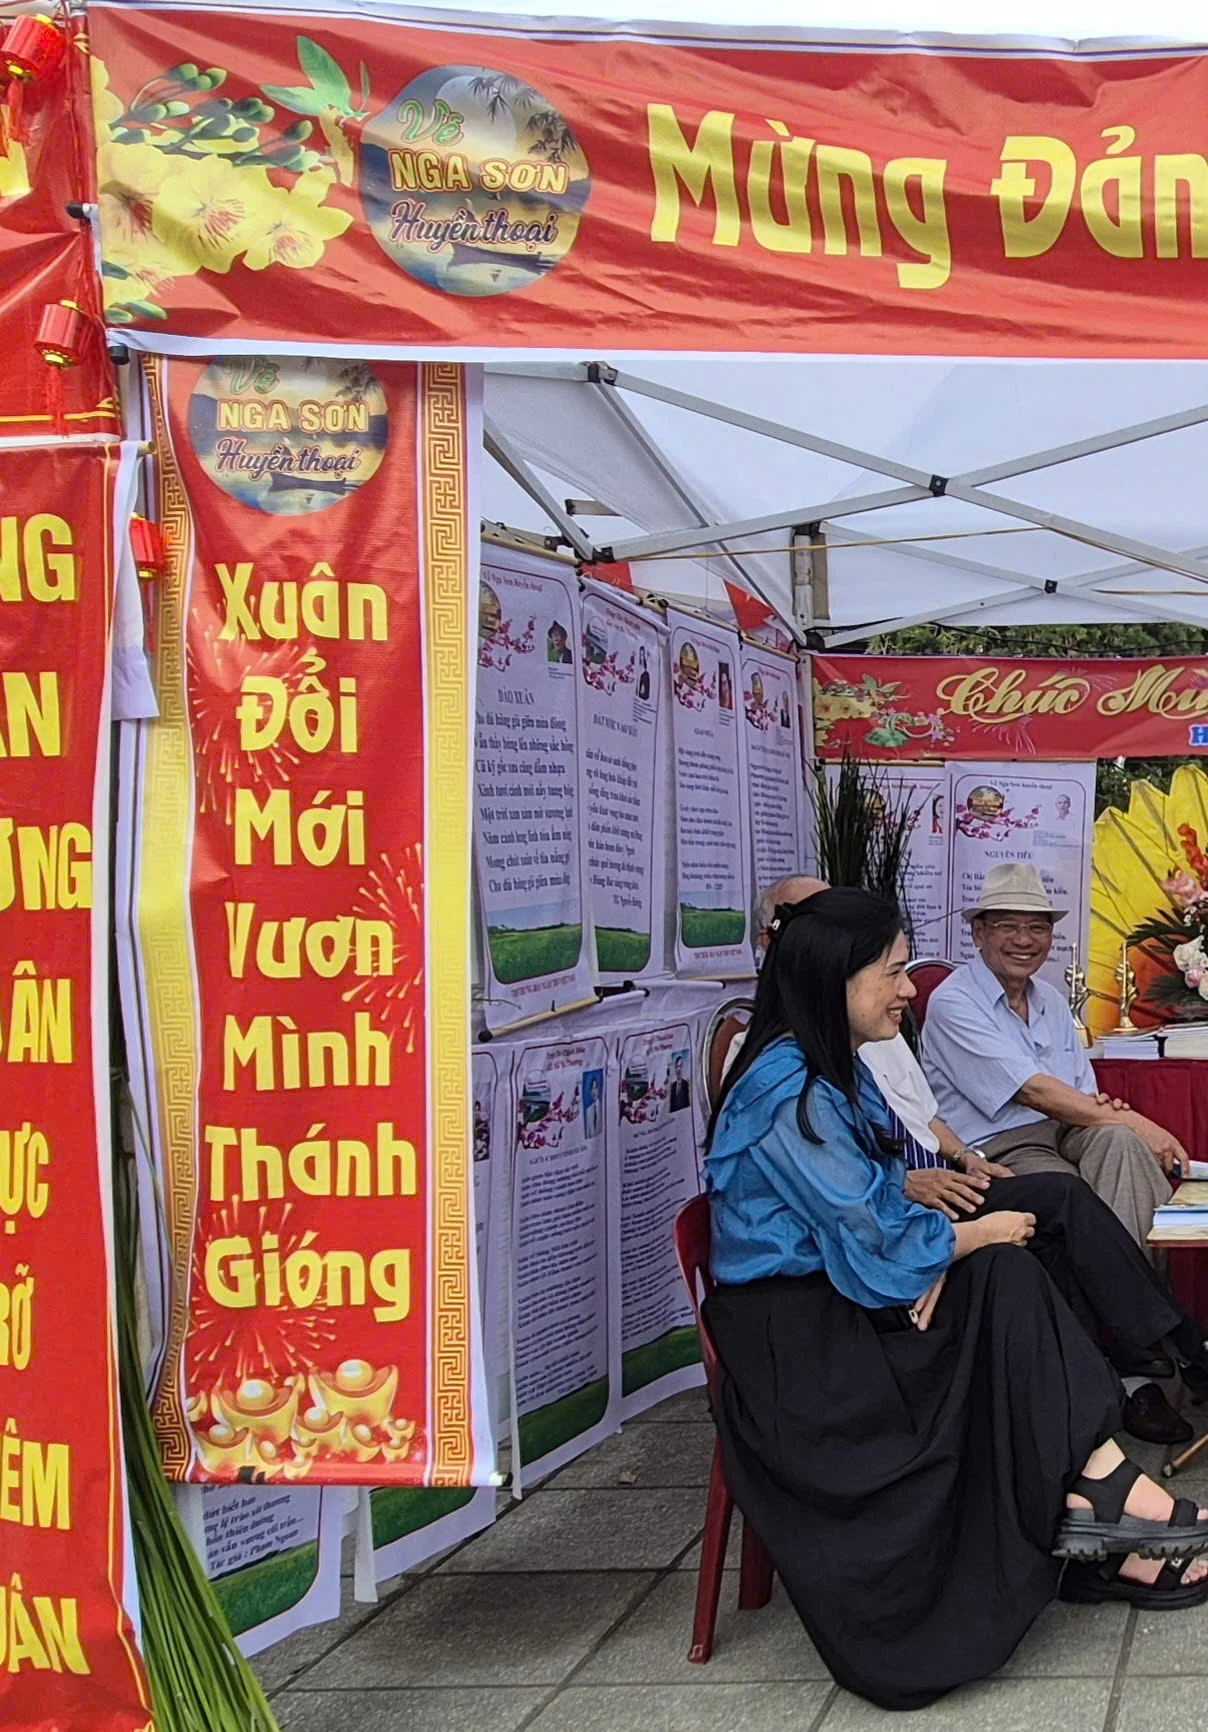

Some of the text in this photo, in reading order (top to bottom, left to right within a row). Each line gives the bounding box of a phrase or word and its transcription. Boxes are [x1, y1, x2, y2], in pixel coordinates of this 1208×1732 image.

[399, 98, 468, 146] Về
[389, 152, 569, 194] NGA SƠN
[647, 103, 951, 289] Mừng
[218, 400, 369, 433] NGA SƠN
[215, 561, 389, 642] Xuân
[0, 672, 60, 757] N
[236, 648, 358, 753] Đổi
[936, 666, 1091, 724] Chúc
[234, 789, 366, 866] Mới
[225, 902, 395, 978] Vươn
[224, 1009, 391, 1092] Mình
[204, 1121, 416, 1203] Thánh
[204, 1232, 412, 1322] Gióng
